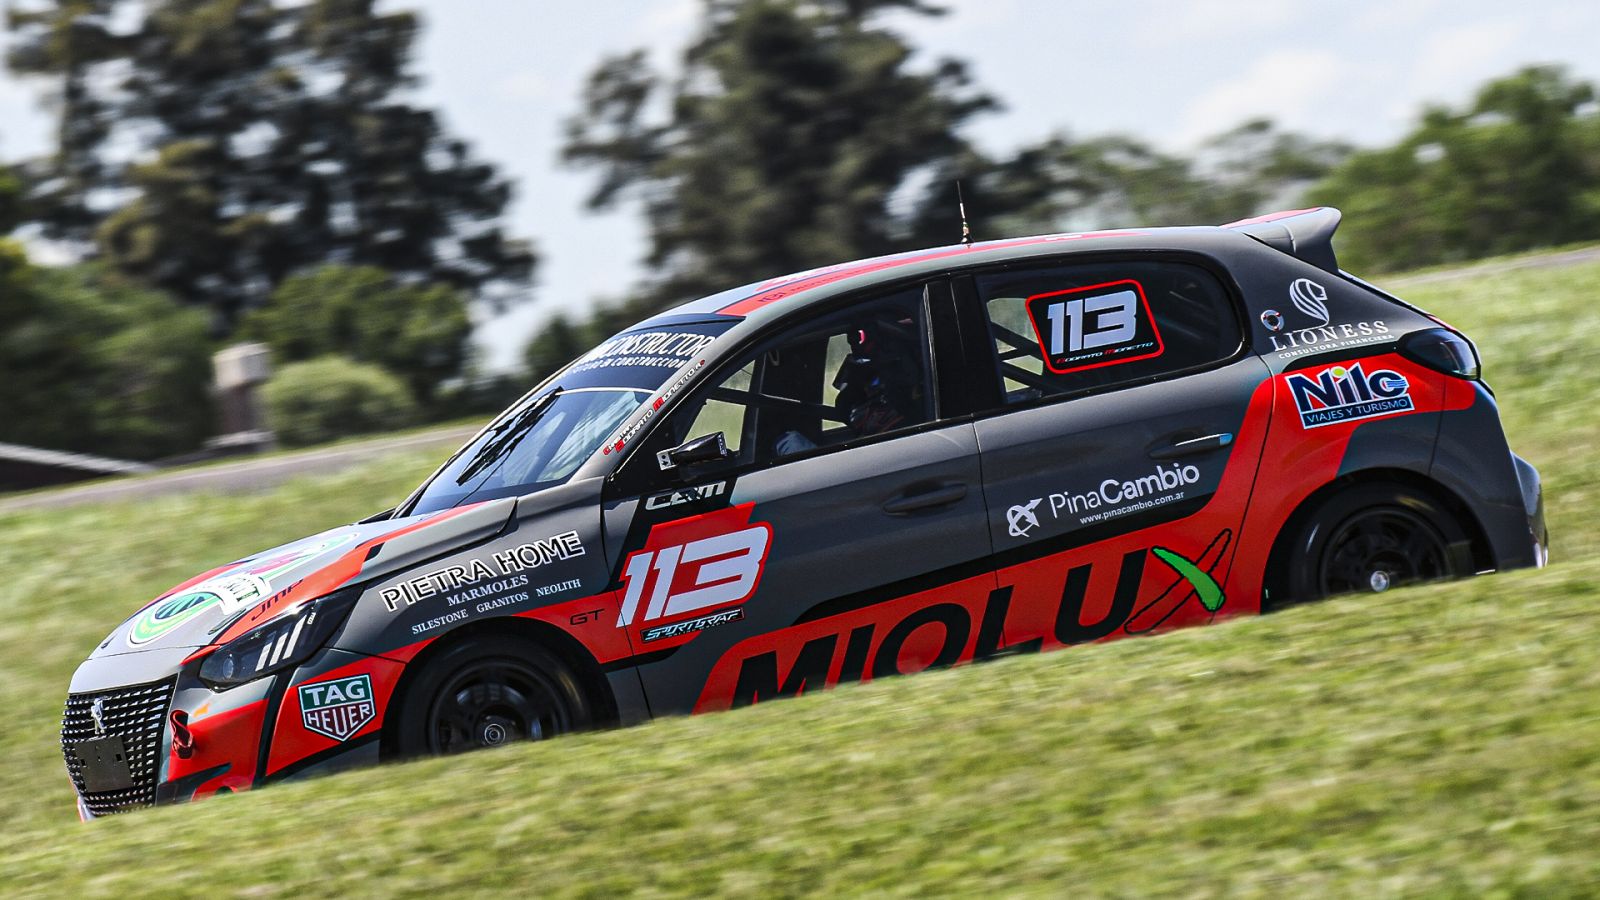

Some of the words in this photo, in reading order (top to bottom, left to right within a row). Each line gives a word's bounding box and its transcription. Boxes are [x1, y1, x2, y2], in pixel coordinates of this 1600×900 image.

[1047, 290, 1137, 356] 113
[1269, 320, 1390, 353] LIONESS
[1278, 342, 1339, 360] CONSULTORA
[1340, 333, 1395, 349] FINANCIERA
[1306, 409, 1344, 423] VIAJES
[1346, 408, 1354, 417] Y
[1355, 398, 1408, 414] TURISMO
[1049, 463, 1200, 519] PinaCambio
[1080, 490, 1185, 525] www.pinacambio.com.ar
[379, 557, 495, 612] PIETRA
[495, 529, 586, 574] HOME
[616, 525, 769, 628] 113
[412, 608, 469, 635] SILESTONE
[476, 590, 529, 614] GRANITOS
[536, 577, 582, 598] NEOLITH
[447, 574, 529, 607] MARMOLES
[569, 608, 606, 626] GT
[305, 680, 366, 706] TAG
[307, 703, 371, 739] HEUER
